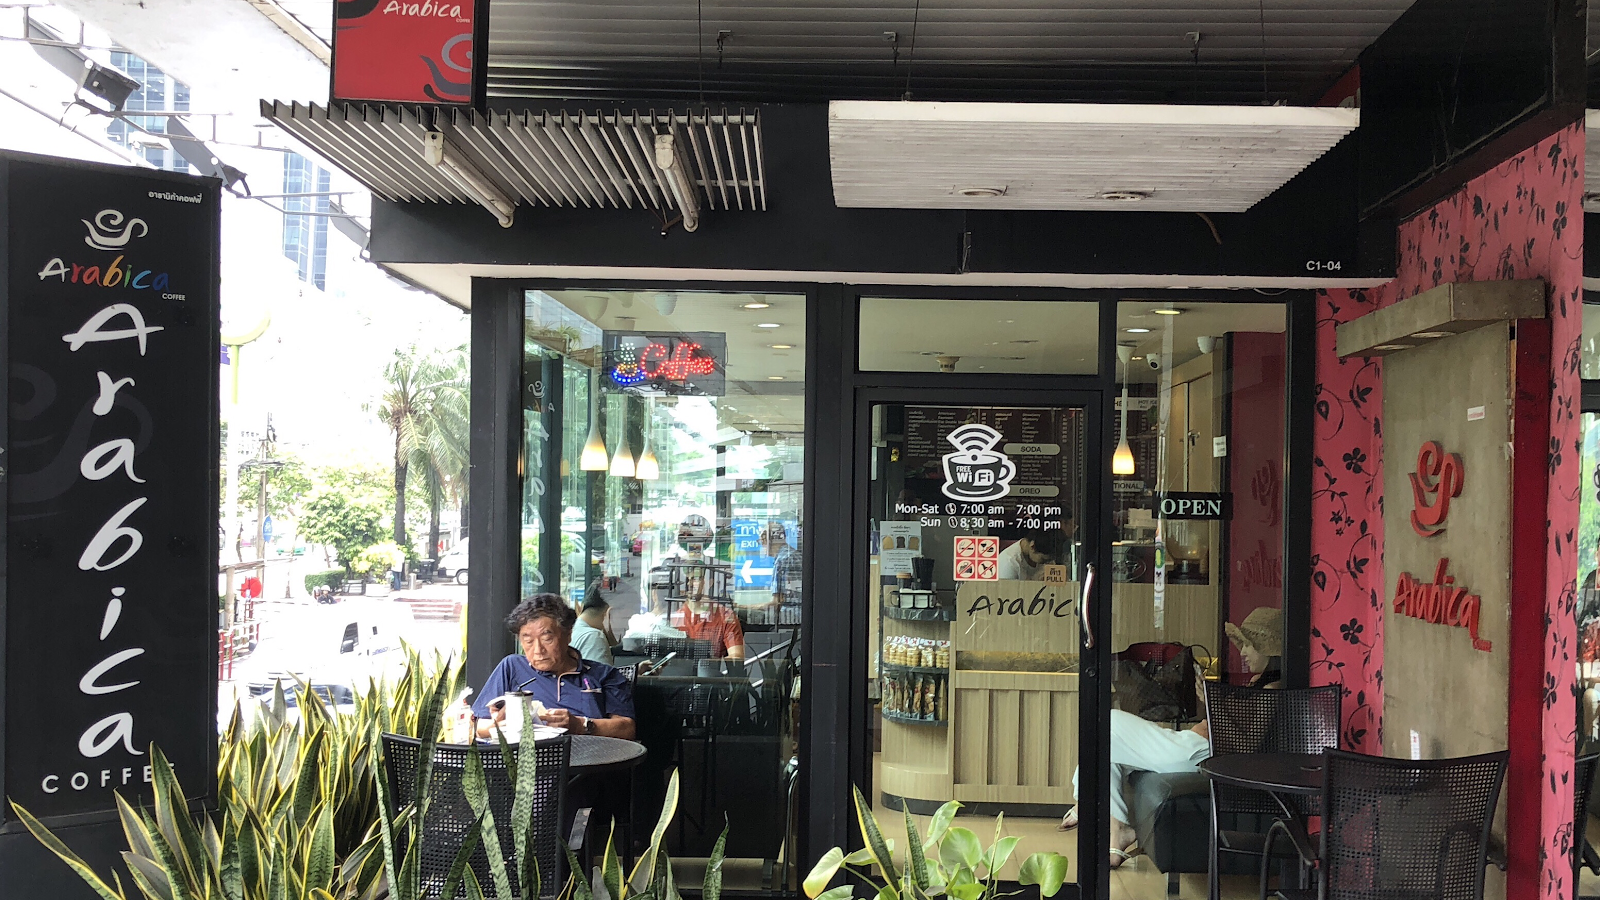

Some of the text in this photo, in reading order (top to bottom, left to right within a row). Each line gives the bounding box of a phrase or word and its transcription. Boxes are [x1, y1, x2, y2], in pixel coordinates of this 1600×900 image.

[383, 0, 462, 18] Arabica
[38, 255, 170, 292] Arabica
[1306, 260, 1342, 271] C1-04
[162, 292, 186, 301] COFFEE
[640, 342, 715, 380] Coffee
[895, 503, 939, 514] Mon-Sat
[960, 504, 984, 514] 7:00
[987, 505, 1005, 515] am
[1016, 504, 1041, 515] 7:00
[1043, 506, 1062, 518] pm
[1160, 498, 1222, 516] OPEN
[62, 303, 165, 758] Arabica
[920, 516, 941, 527] Sun
[960, 517, 984, 528] 8:30
[987, 519, 1005, 528] am
[1016, 518, 1040, 529] 7:00
[1043, 520, 1061, 531] pm
[966, 585, 1079, 617] Arabic
[1393, 557, 1481, 640] Arabica
